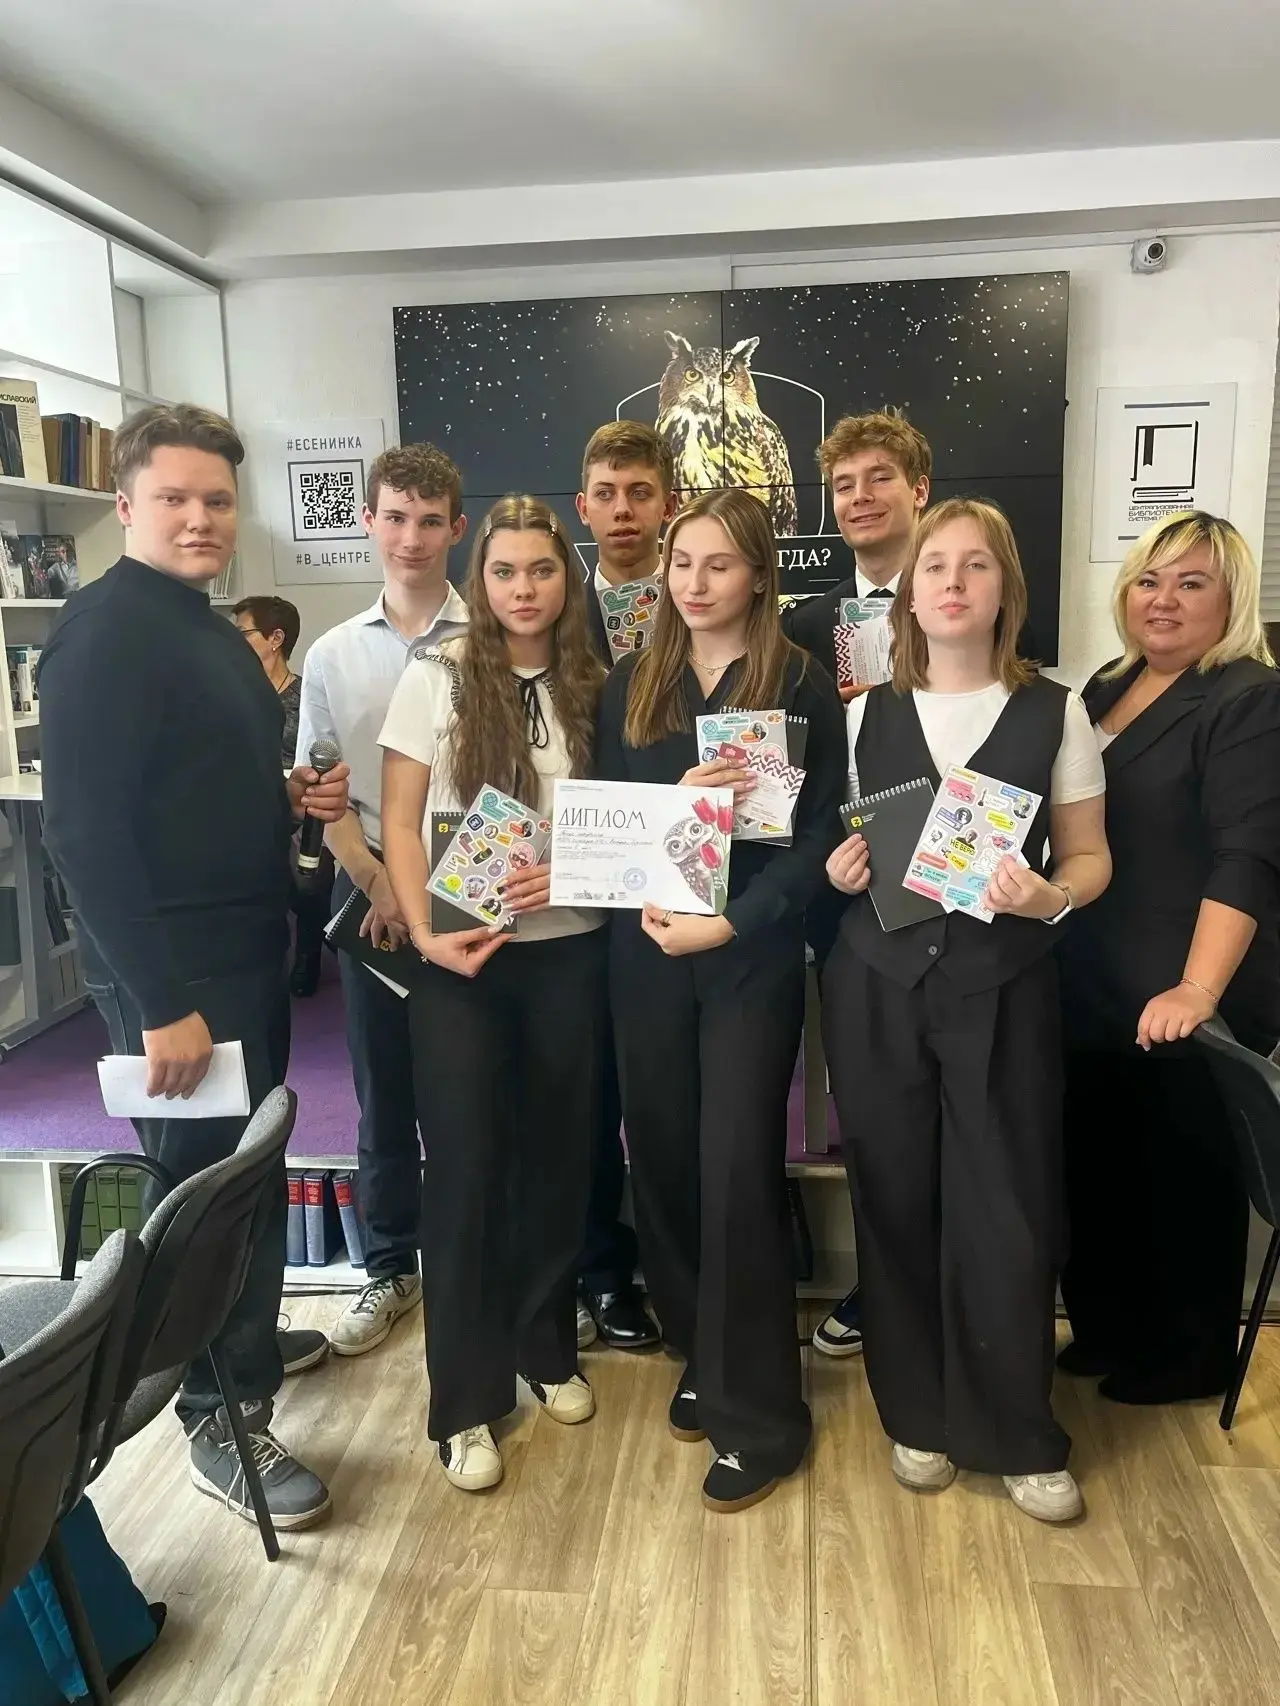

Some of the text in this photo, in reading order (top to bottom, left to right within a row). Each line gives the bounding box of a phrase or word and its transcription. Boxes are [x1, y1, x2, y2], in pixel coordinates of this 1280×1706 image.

[287, 436, 362, 451] #ЕСЕНИНКА
[296, 551, 371, 567] #В_ЦЕНТРЕ
[557, 808, 646, 829] ДИПЛОМ
